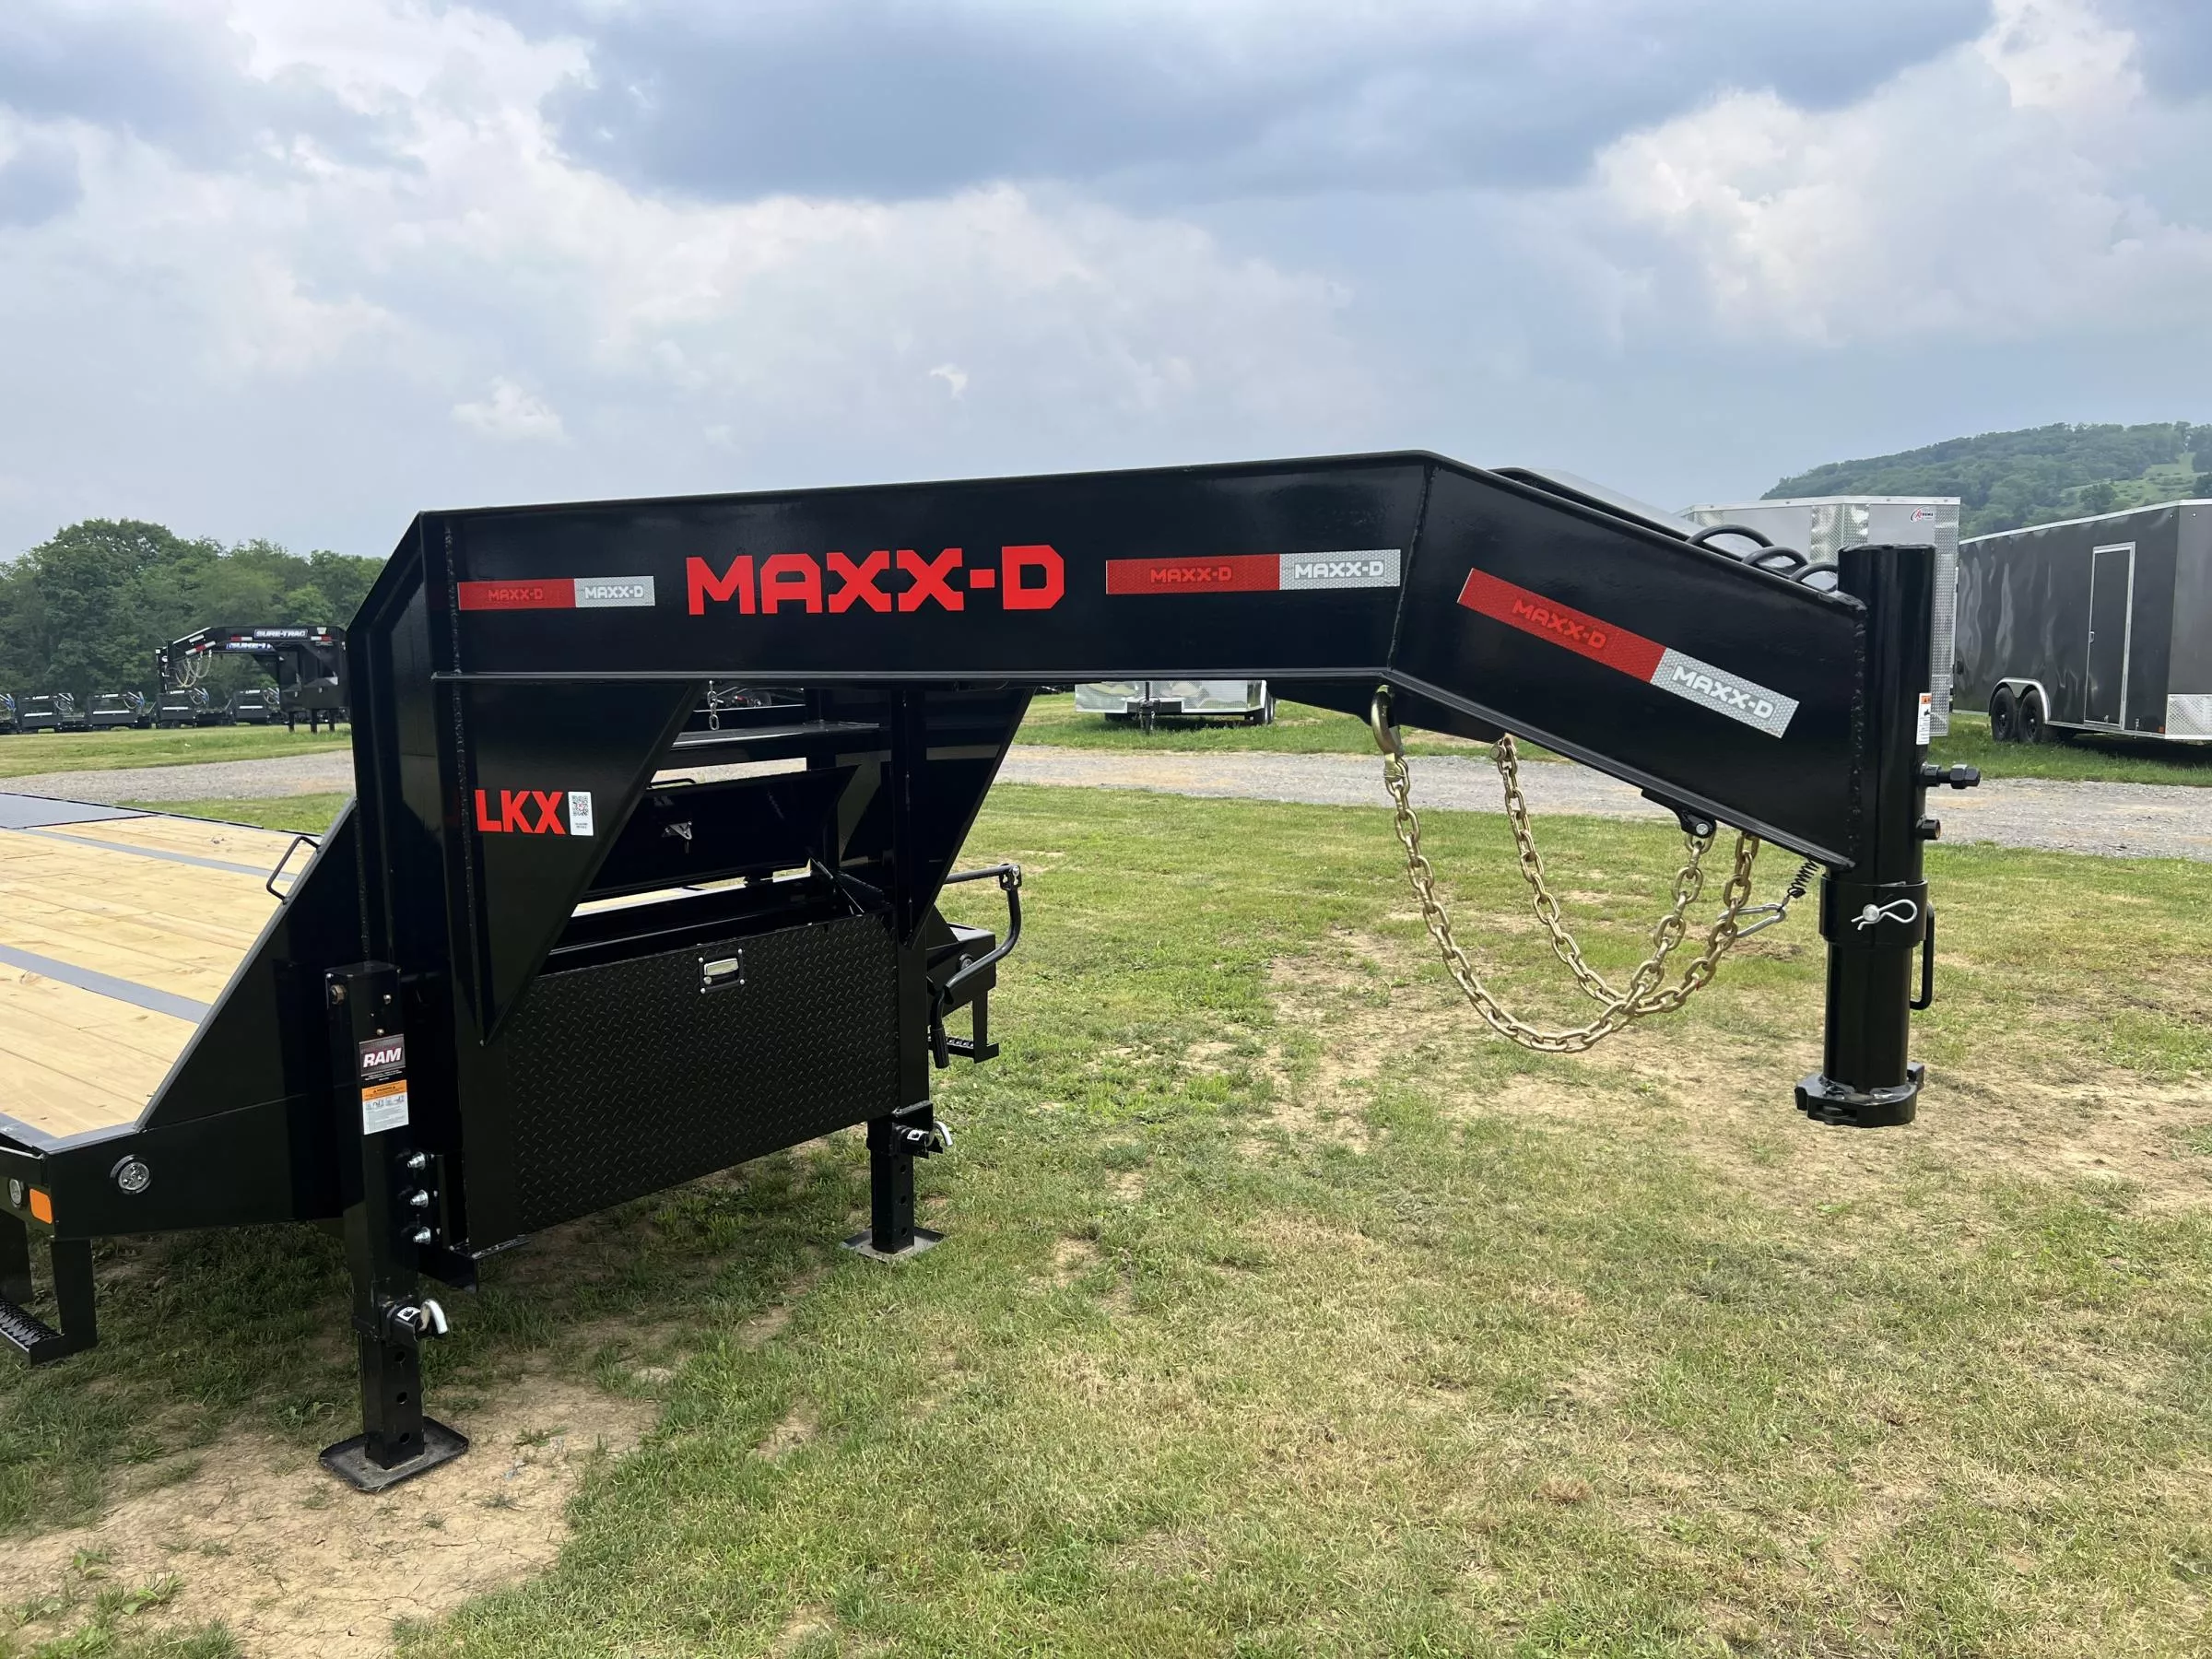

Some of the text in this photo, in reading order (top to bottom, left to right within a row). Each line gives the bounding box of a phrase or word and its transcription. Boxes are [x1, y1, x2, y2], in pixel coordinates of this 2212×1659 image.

[686, 544, 1065, 616] MAXX-D
[1150, 561, 1384, 582] MAXX-D MAXX-D
[488, 585, 644, 601] MAXX-D MAXX-D
[1512, 599, 1774, 719] MAXX-D MAXX-D
[475, 789, 566, 835] LKX
[363, 1047, 403, 1068] RAM
